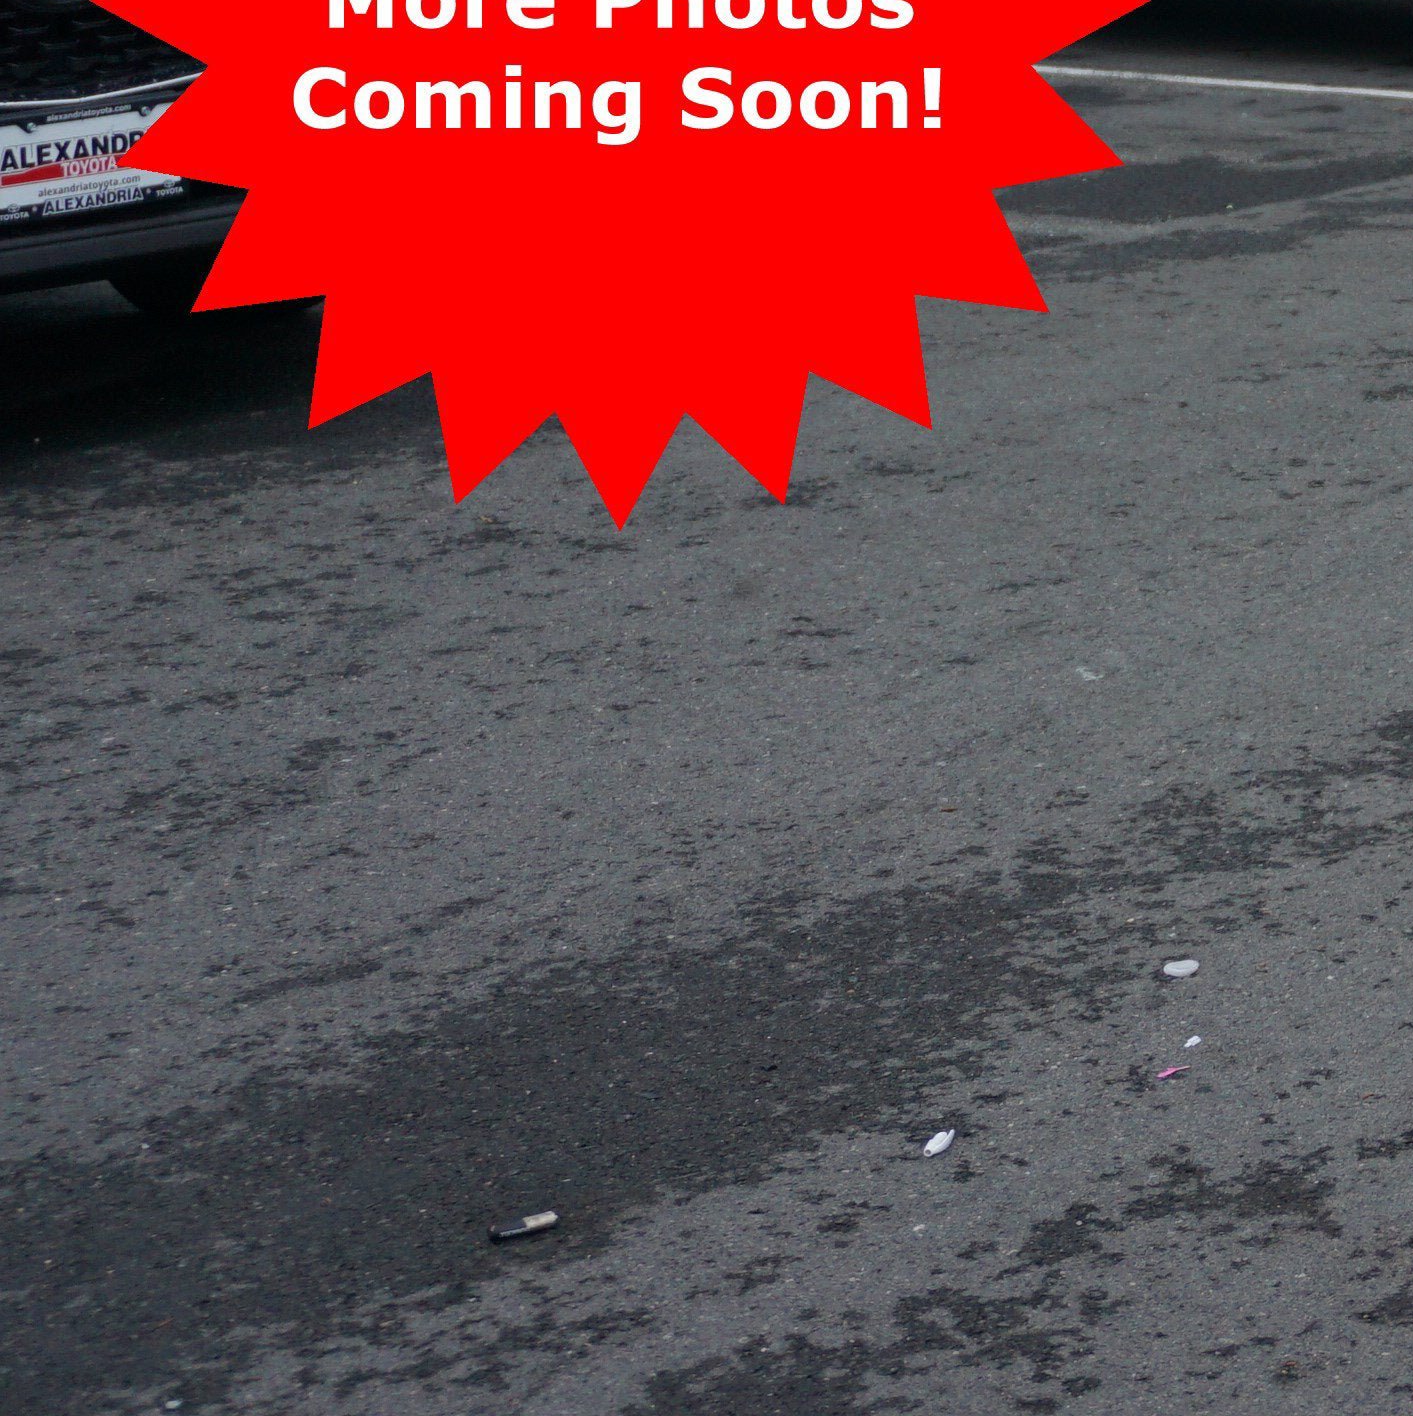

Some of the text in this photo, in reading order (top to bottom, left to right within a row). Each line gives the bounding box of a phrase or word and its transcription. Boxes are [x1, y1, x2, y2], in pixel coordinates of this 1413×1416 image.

[46, 103, 132, 122] alexandriatoyota.com
[60, 156, 118, 177] TOYOTA
[38, 174, 141, 198] alexandriatoyota.com
[156, 186, 184, 197] TOYOTA
[43, 186, 144, 216] ALEXANDRIA
[0, 211, 30, 222] TOYOTA
